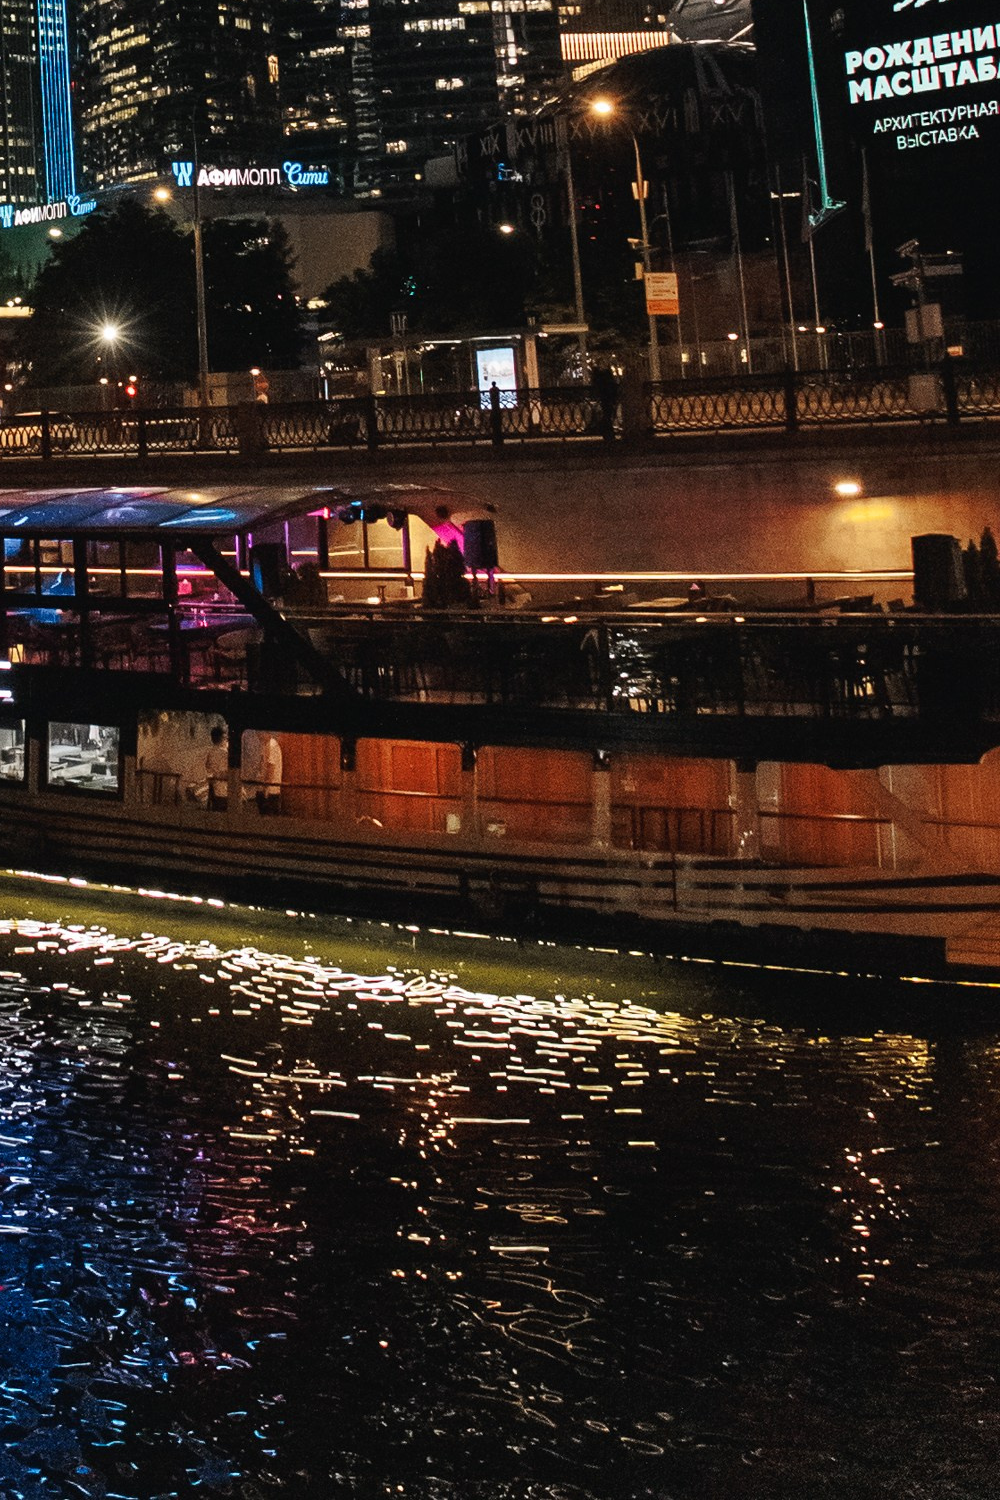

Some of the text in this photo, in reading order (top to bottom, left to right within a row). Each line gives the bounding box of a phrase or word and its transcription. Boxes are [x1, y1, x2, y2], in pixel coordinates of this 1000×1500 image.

[873, 100, 999, 134] АРХИТЕКТУРНАЯ
[896, 124, 980, 150] ВЫСТАВКА
[197, 161, 329, 186] АФИМОЛЛ Сити
[14, 202, 67, 226] АФИМОЛЛ
